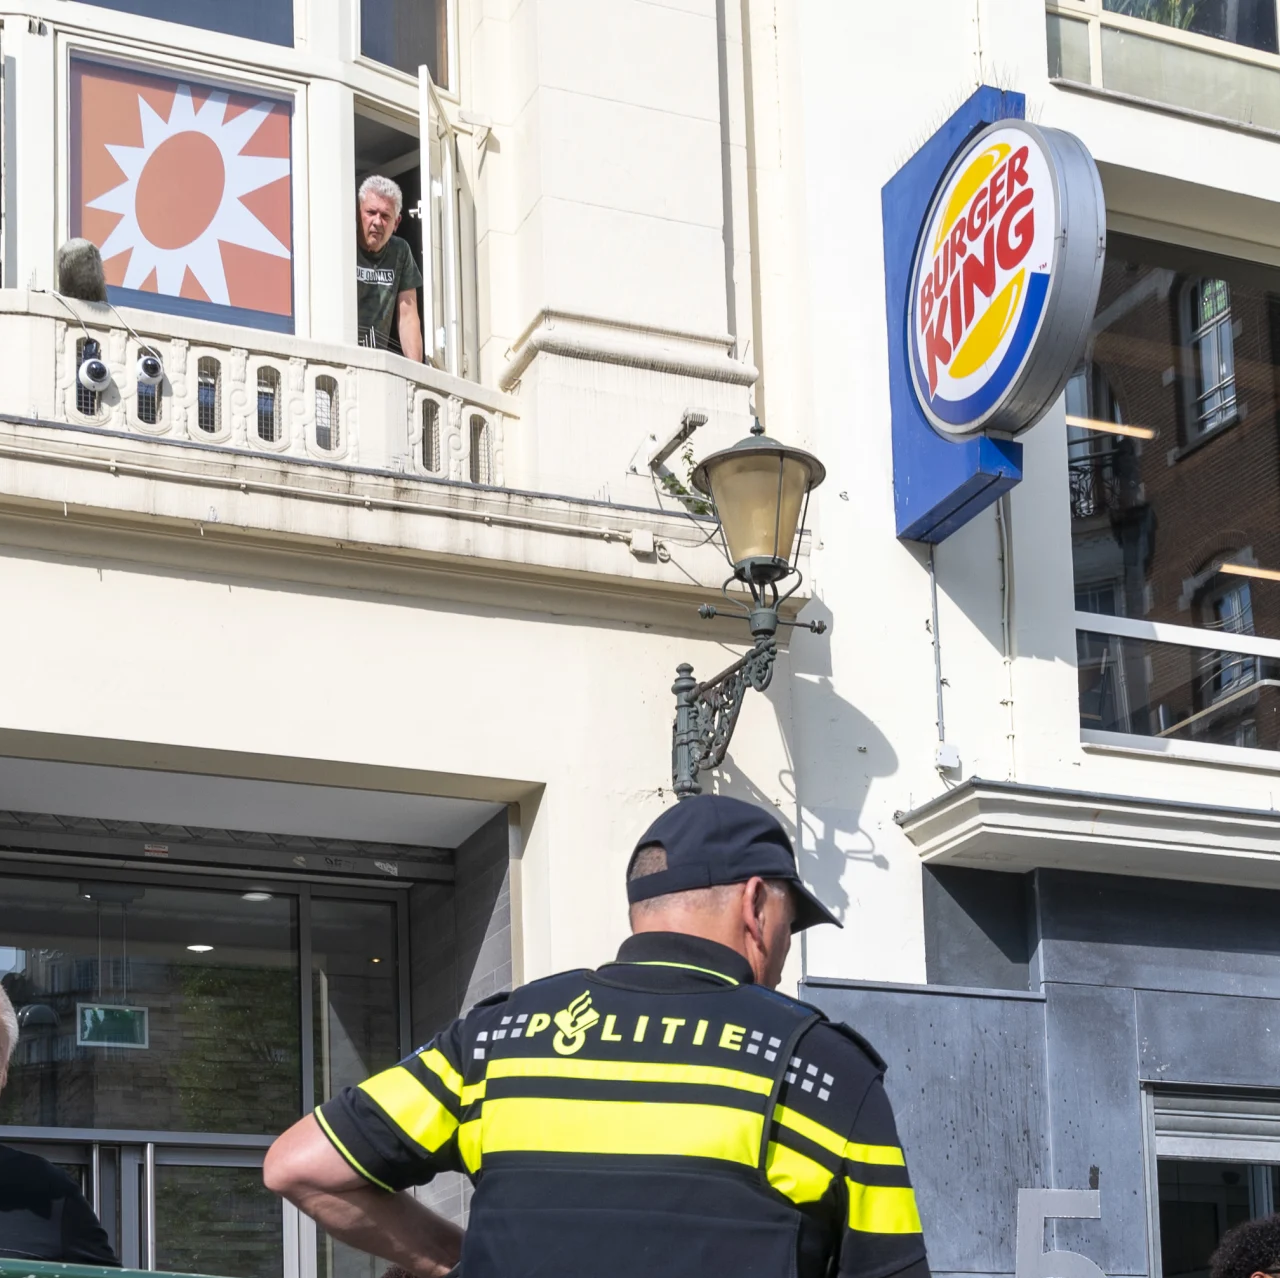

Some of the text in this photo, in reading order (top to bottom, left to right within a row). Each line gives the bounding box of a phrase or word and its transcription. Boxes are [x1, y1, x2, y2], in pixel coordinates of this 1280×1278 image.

[921, 145, 1029, 335] BURGER
[925, 187, 1035, 402] KING
[525, 1002, 747, 1055] POLITIE
